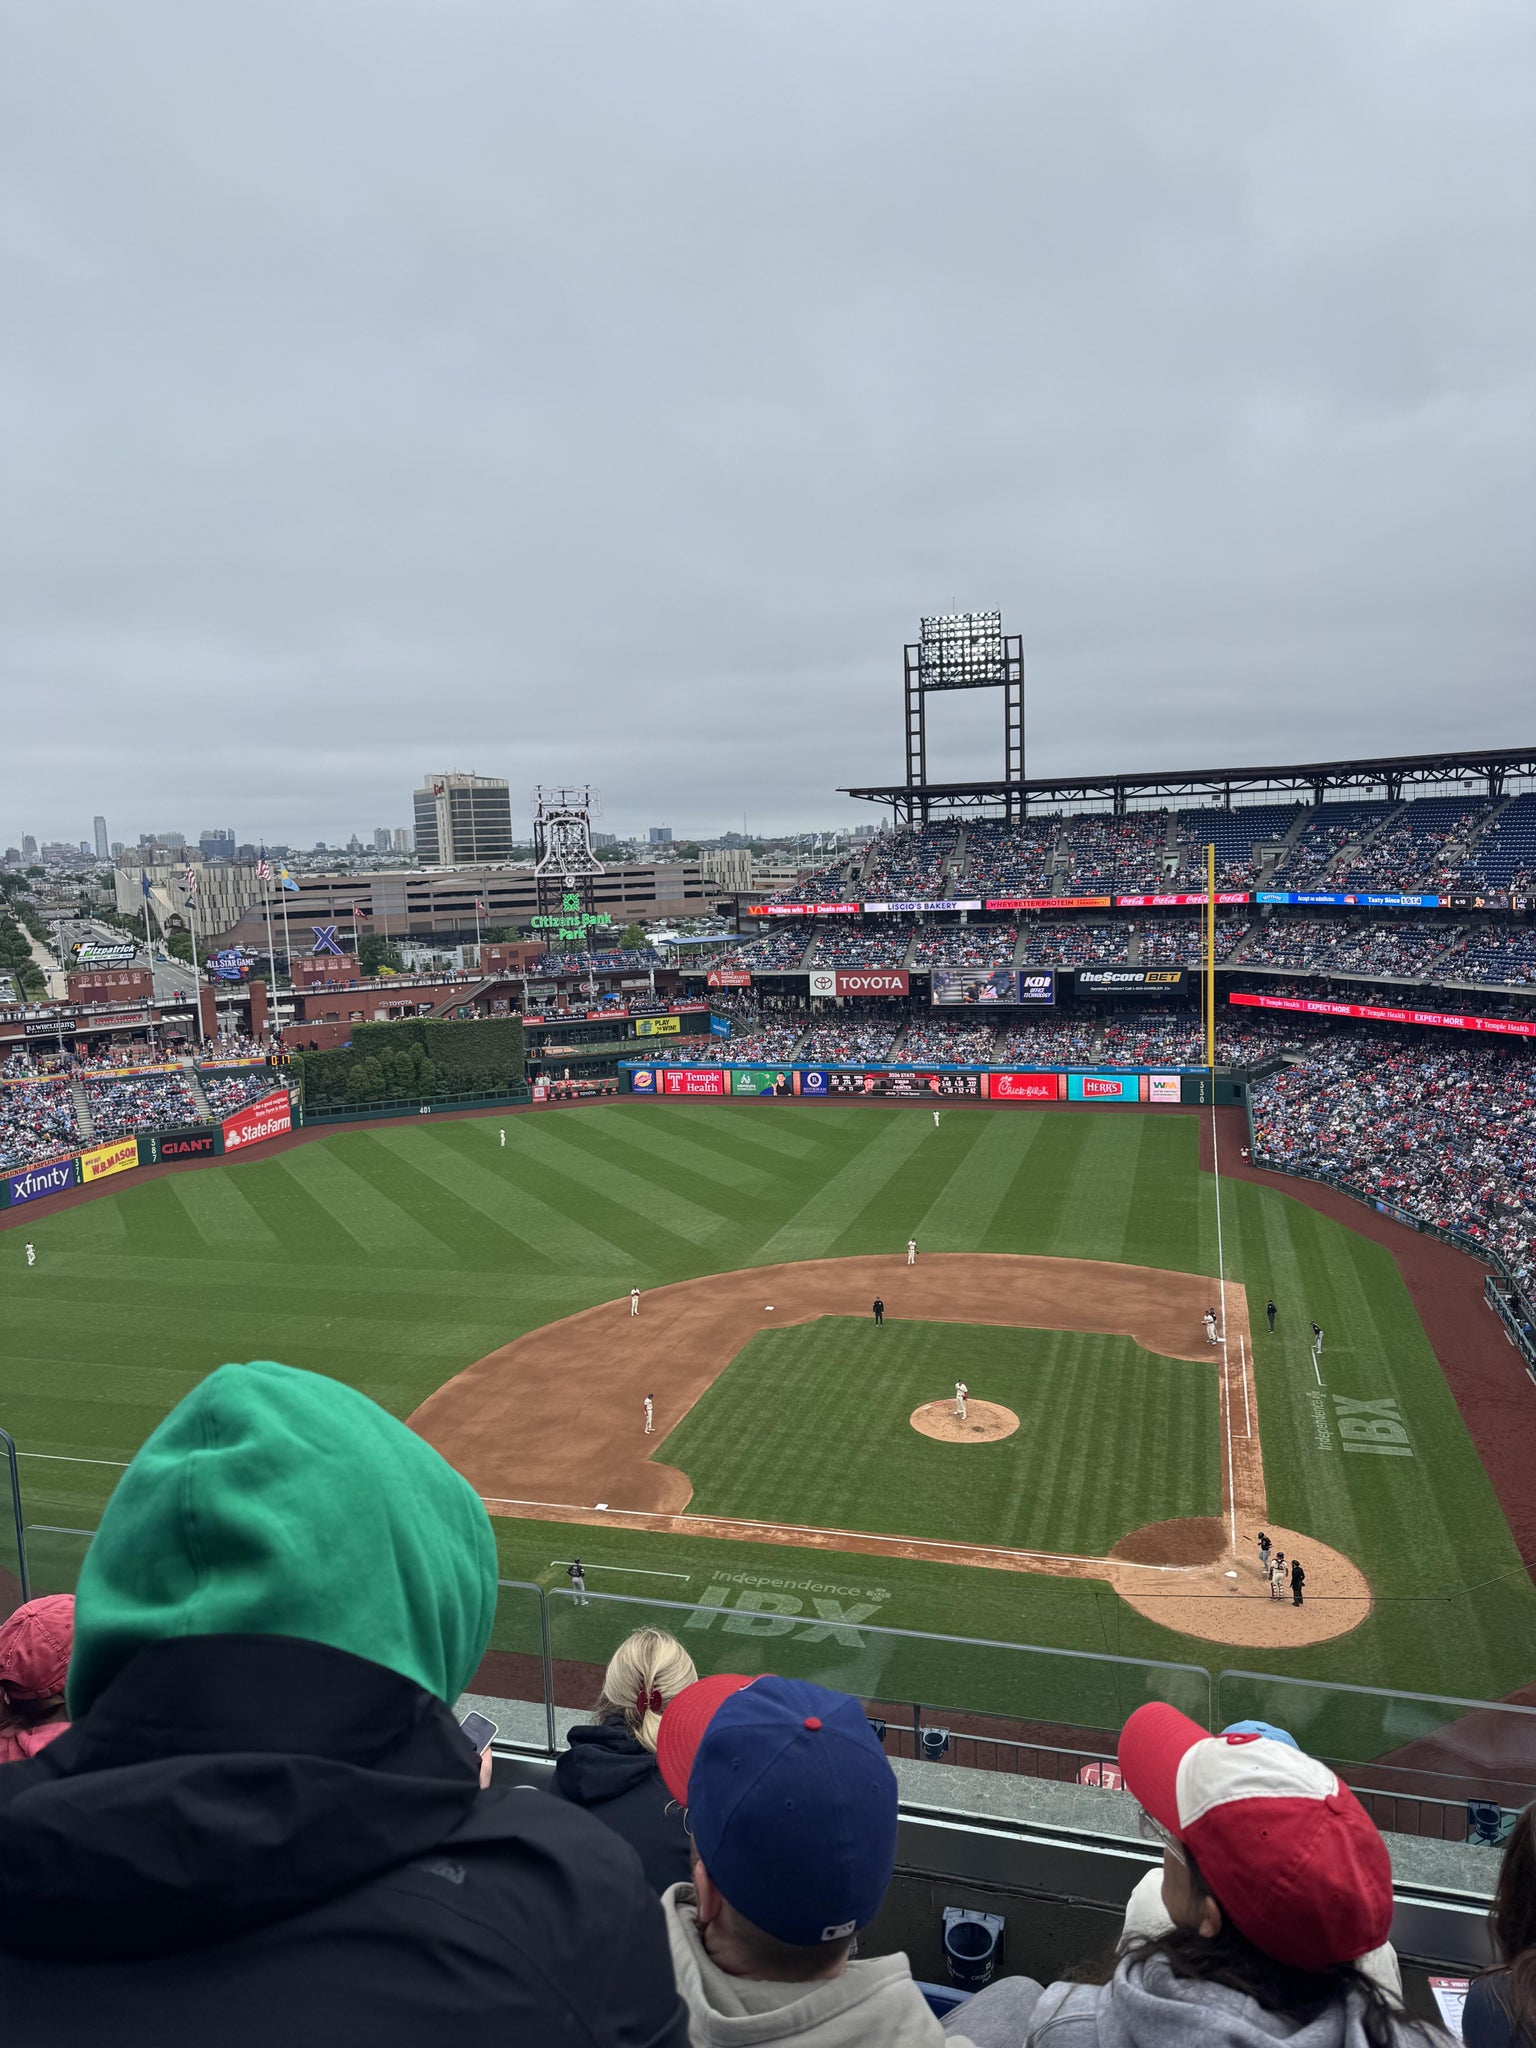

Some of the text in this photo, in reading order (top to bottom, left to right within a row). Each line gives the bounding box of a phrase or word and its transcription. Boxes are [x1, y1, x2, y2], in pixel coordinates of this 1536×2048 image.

[1121, 896, 1144, 905] Coca-Cola
[1153, 896, 1177, 904] Coca-Cola
[1220, 894, 1244, 903] Coca-Cola
[530, 911, 612, 928] Citizens Bank
[559, 927, 586, 940] Park
[77, 942, 135, 957] Fitzpatrick
[207, 958, 255, 968] ALL STAR GAME
[1024, 977, 1052, 987] KDI
[1080, 972, 1144, 982] theScore
[840, 977, 903, 989] TOYOTA
[1308, 1003, 1331, 1012] EXPECT
[1367, 1009, 1386, 1017] Temple
[1387, 1011, 1405, 1019] Health
[1415, 1014, 1441, 1023] EXPECT
[1443, 1017, 1464, 1026] MORE
[1484, 1022, 1506, 1031] Temple
[1508, 1024, 1529, 1032] Health
[271, 1055, 290, 1066] 0:17
[686, 1072, 719, 1083] Temple
[687, 1083, 718, 1092] Health
[999, 1077, 1049, 1096] Chick-fil-A
[1087, 1083, 1118, 1092] HERR'S
[419, 1106, 431, 1114] 401
[161, 1138, 212, 1154] GIANT
[0, 1166, 28, 1178] SPLUNDH
[14, 1168, 69, 1198] xfinity
[1312, 1399, 1334, 1451] Independence
[1332, 1394, 1413, 1457] IBX
[712, 1570, 861, 1596] Independence
[683, 1585, 883, 1648] IBX
